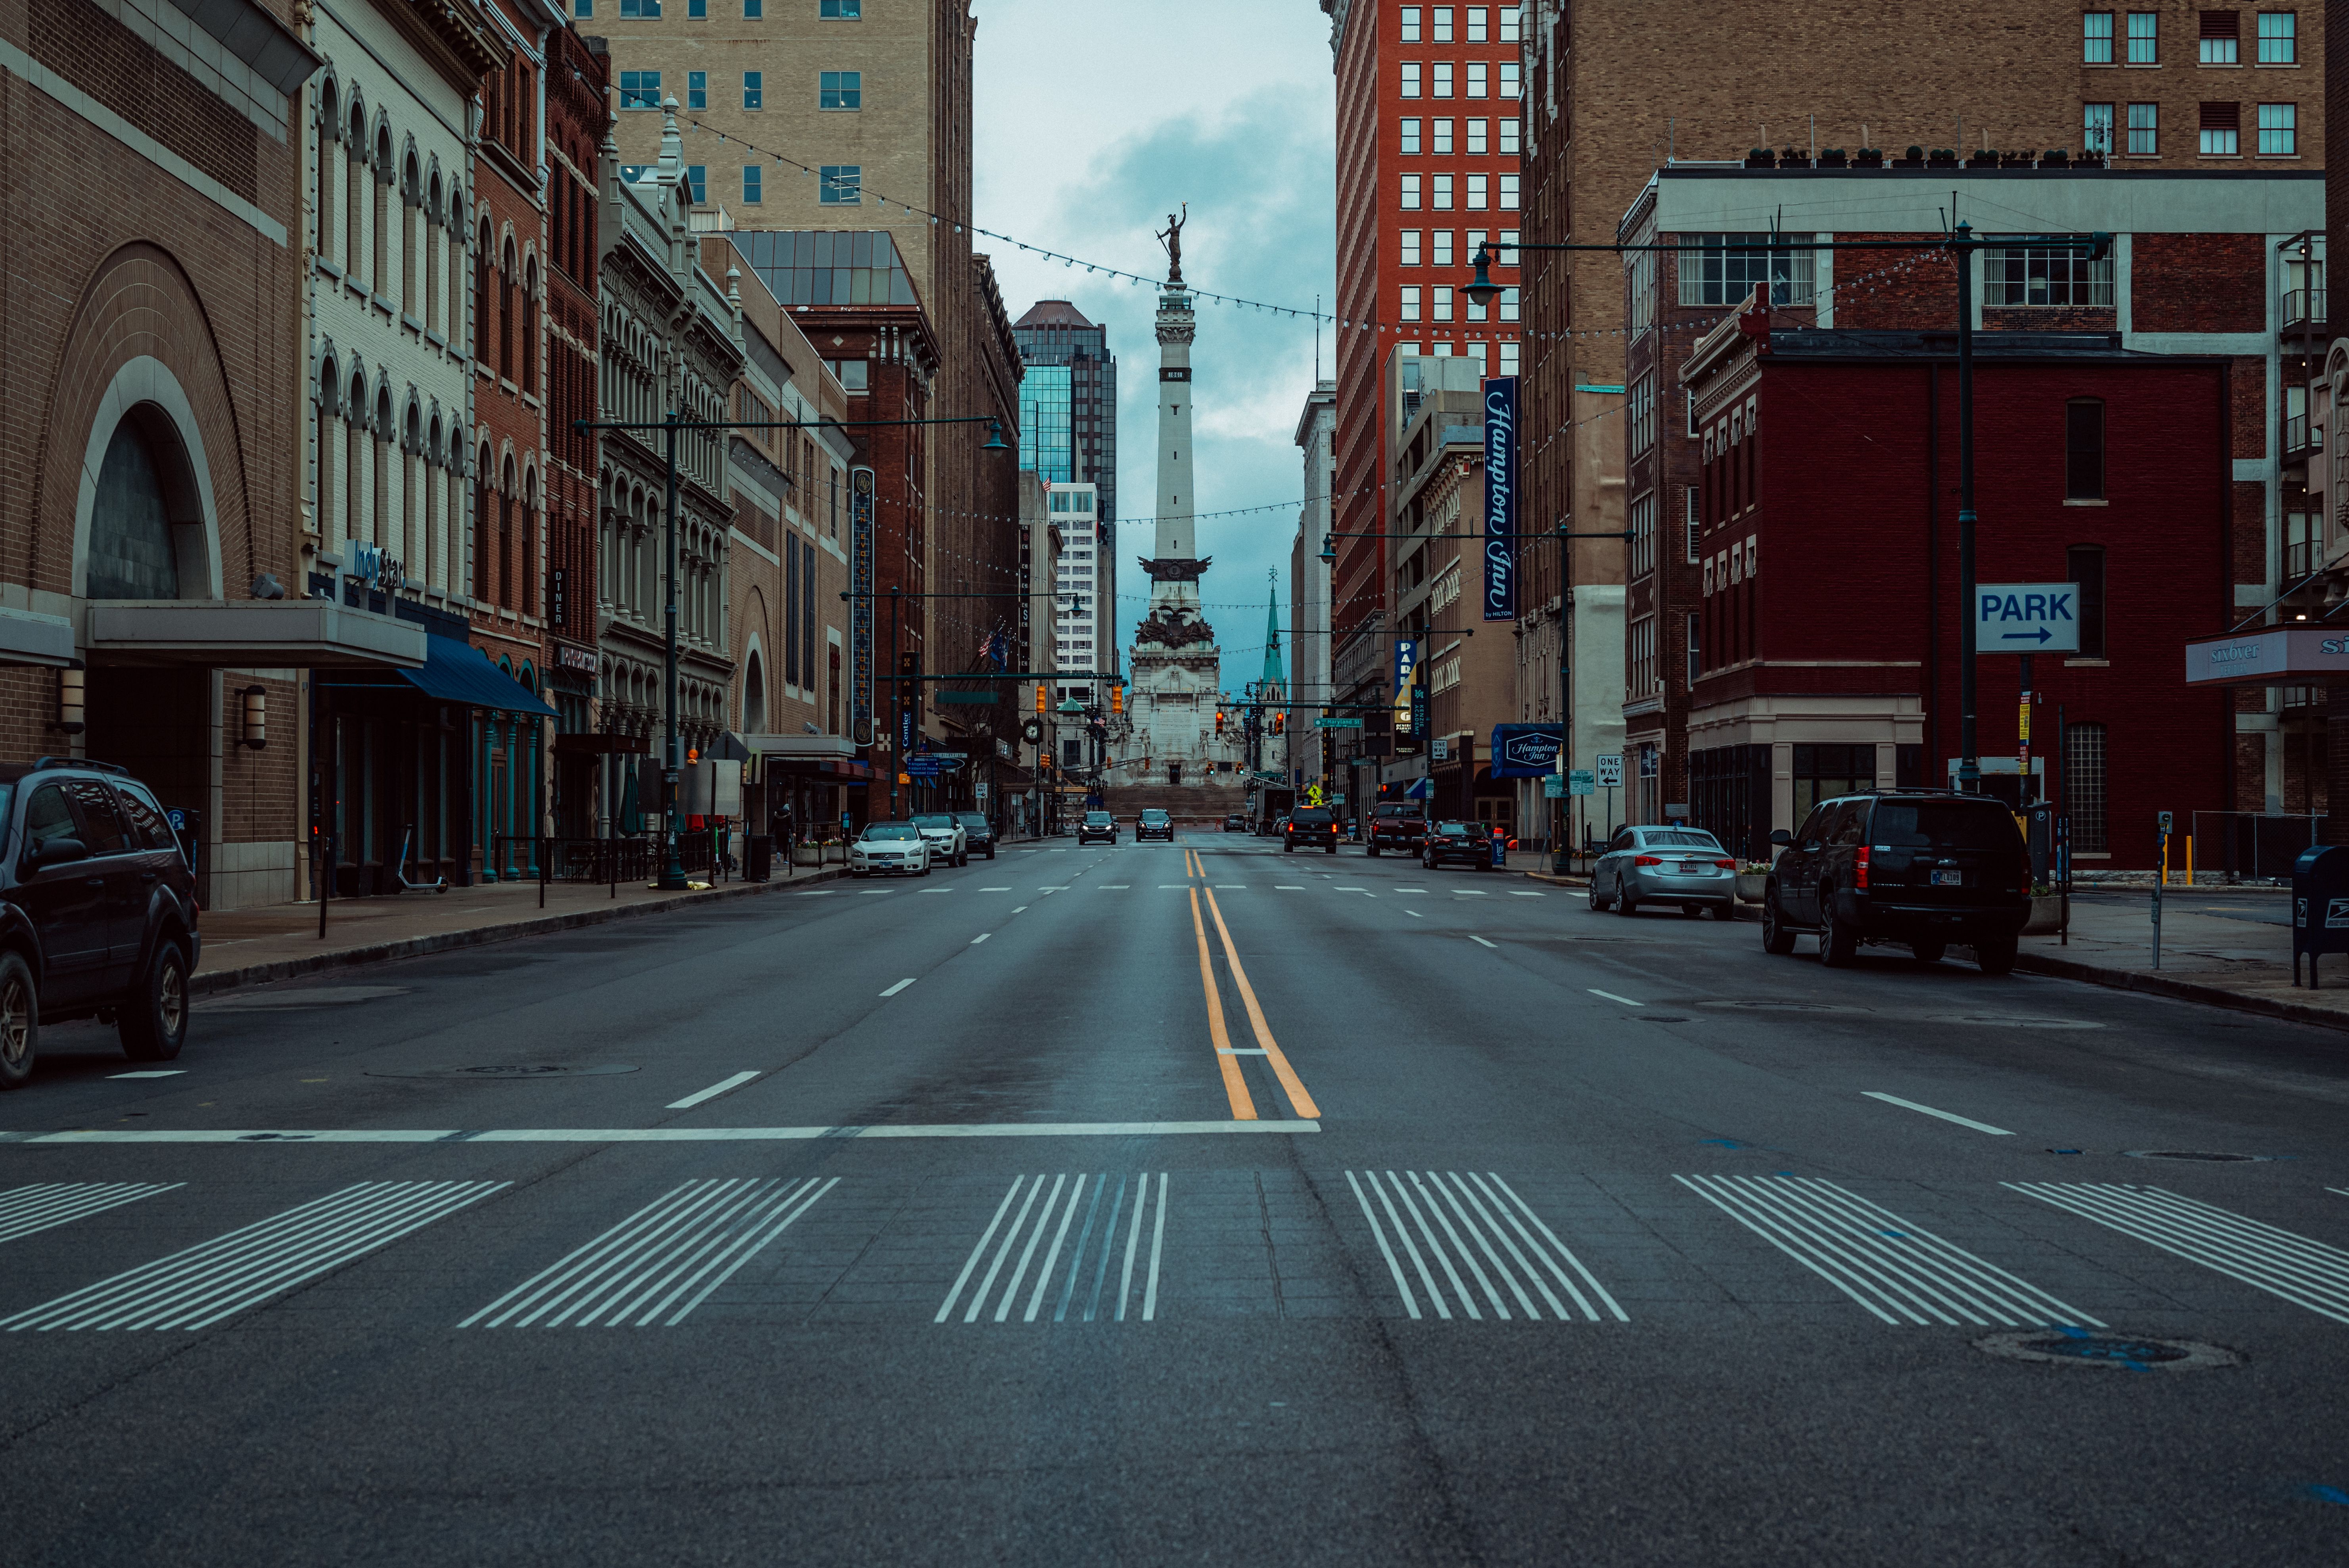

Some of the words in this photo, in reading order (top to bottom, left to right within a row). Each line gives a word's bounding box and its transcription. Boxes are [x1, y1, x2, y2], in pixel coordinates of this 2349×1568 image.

[1487, 391, 1512, 535] Hampton
[1487, 541, 1511, 608] Inn
[1982, 594, 2073, 621] PARK
[860, 619, 866, 634] IN
[1400, 642, 1411, 721] PARKING
[1512, 743, 1561, 754] Hampton
[1524, 751, 1549, 761] Inn
[172, 813, 181, 827] P
